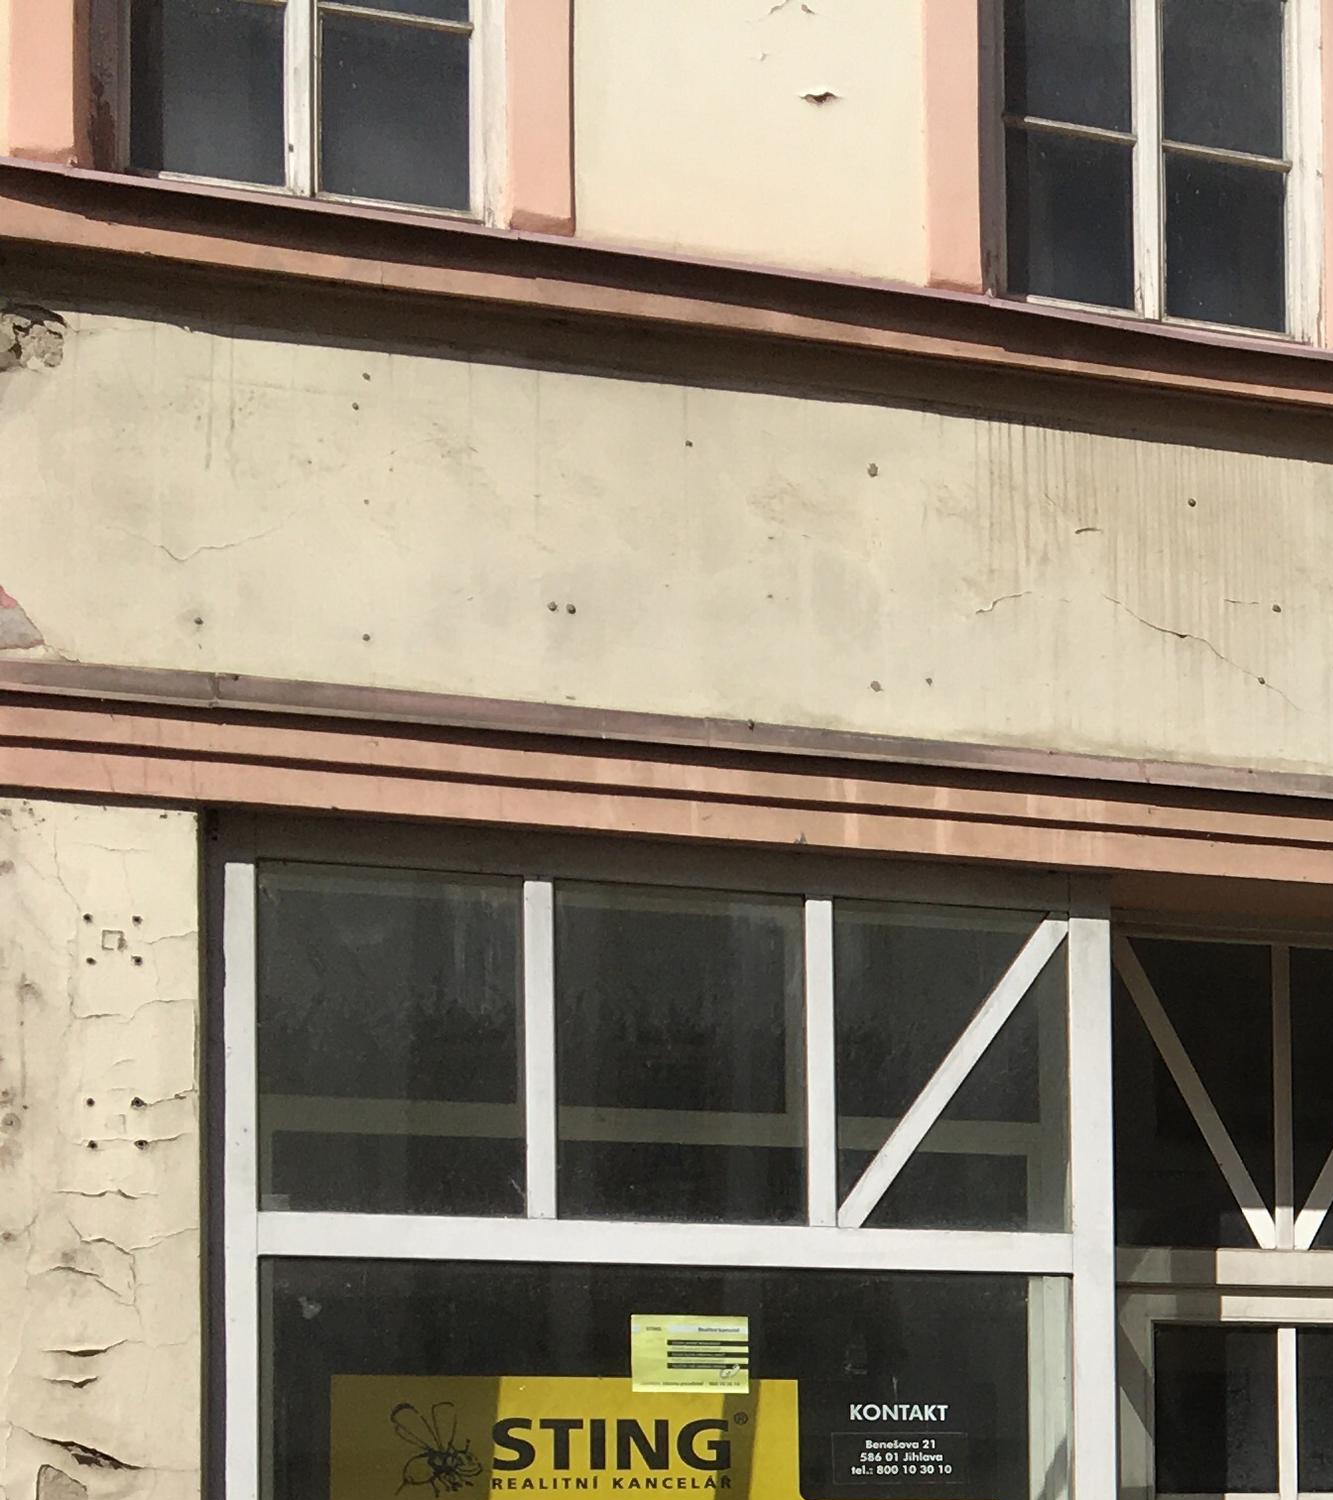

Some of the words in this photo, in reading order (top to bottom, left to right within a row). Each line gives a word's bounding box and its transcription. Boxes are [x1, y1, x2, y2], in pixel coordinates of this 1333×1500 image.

[849, 1404, 949, 1421] KONTAKT
[491, 1417, 731, 1471] STING
[865, 1439, 920, 1450] Benešova
[922, 1439, 936, 1449] 21
[860, 1452, 882, 1462] 586
[885, 1452, 899, 1462] 01
[903, 1452, 944, 1462] Jihlava
[876, 1465, 899, 1475] 800
[902, 1465, 916, 1474] 10
[920, 1465, 934, 1474] 30
[938, 1464, 952, 1474] 10
[491, 1475, 598, 1490] REALITNÍ
[612, 1474, 732, 1490] KANCELÁŘ
